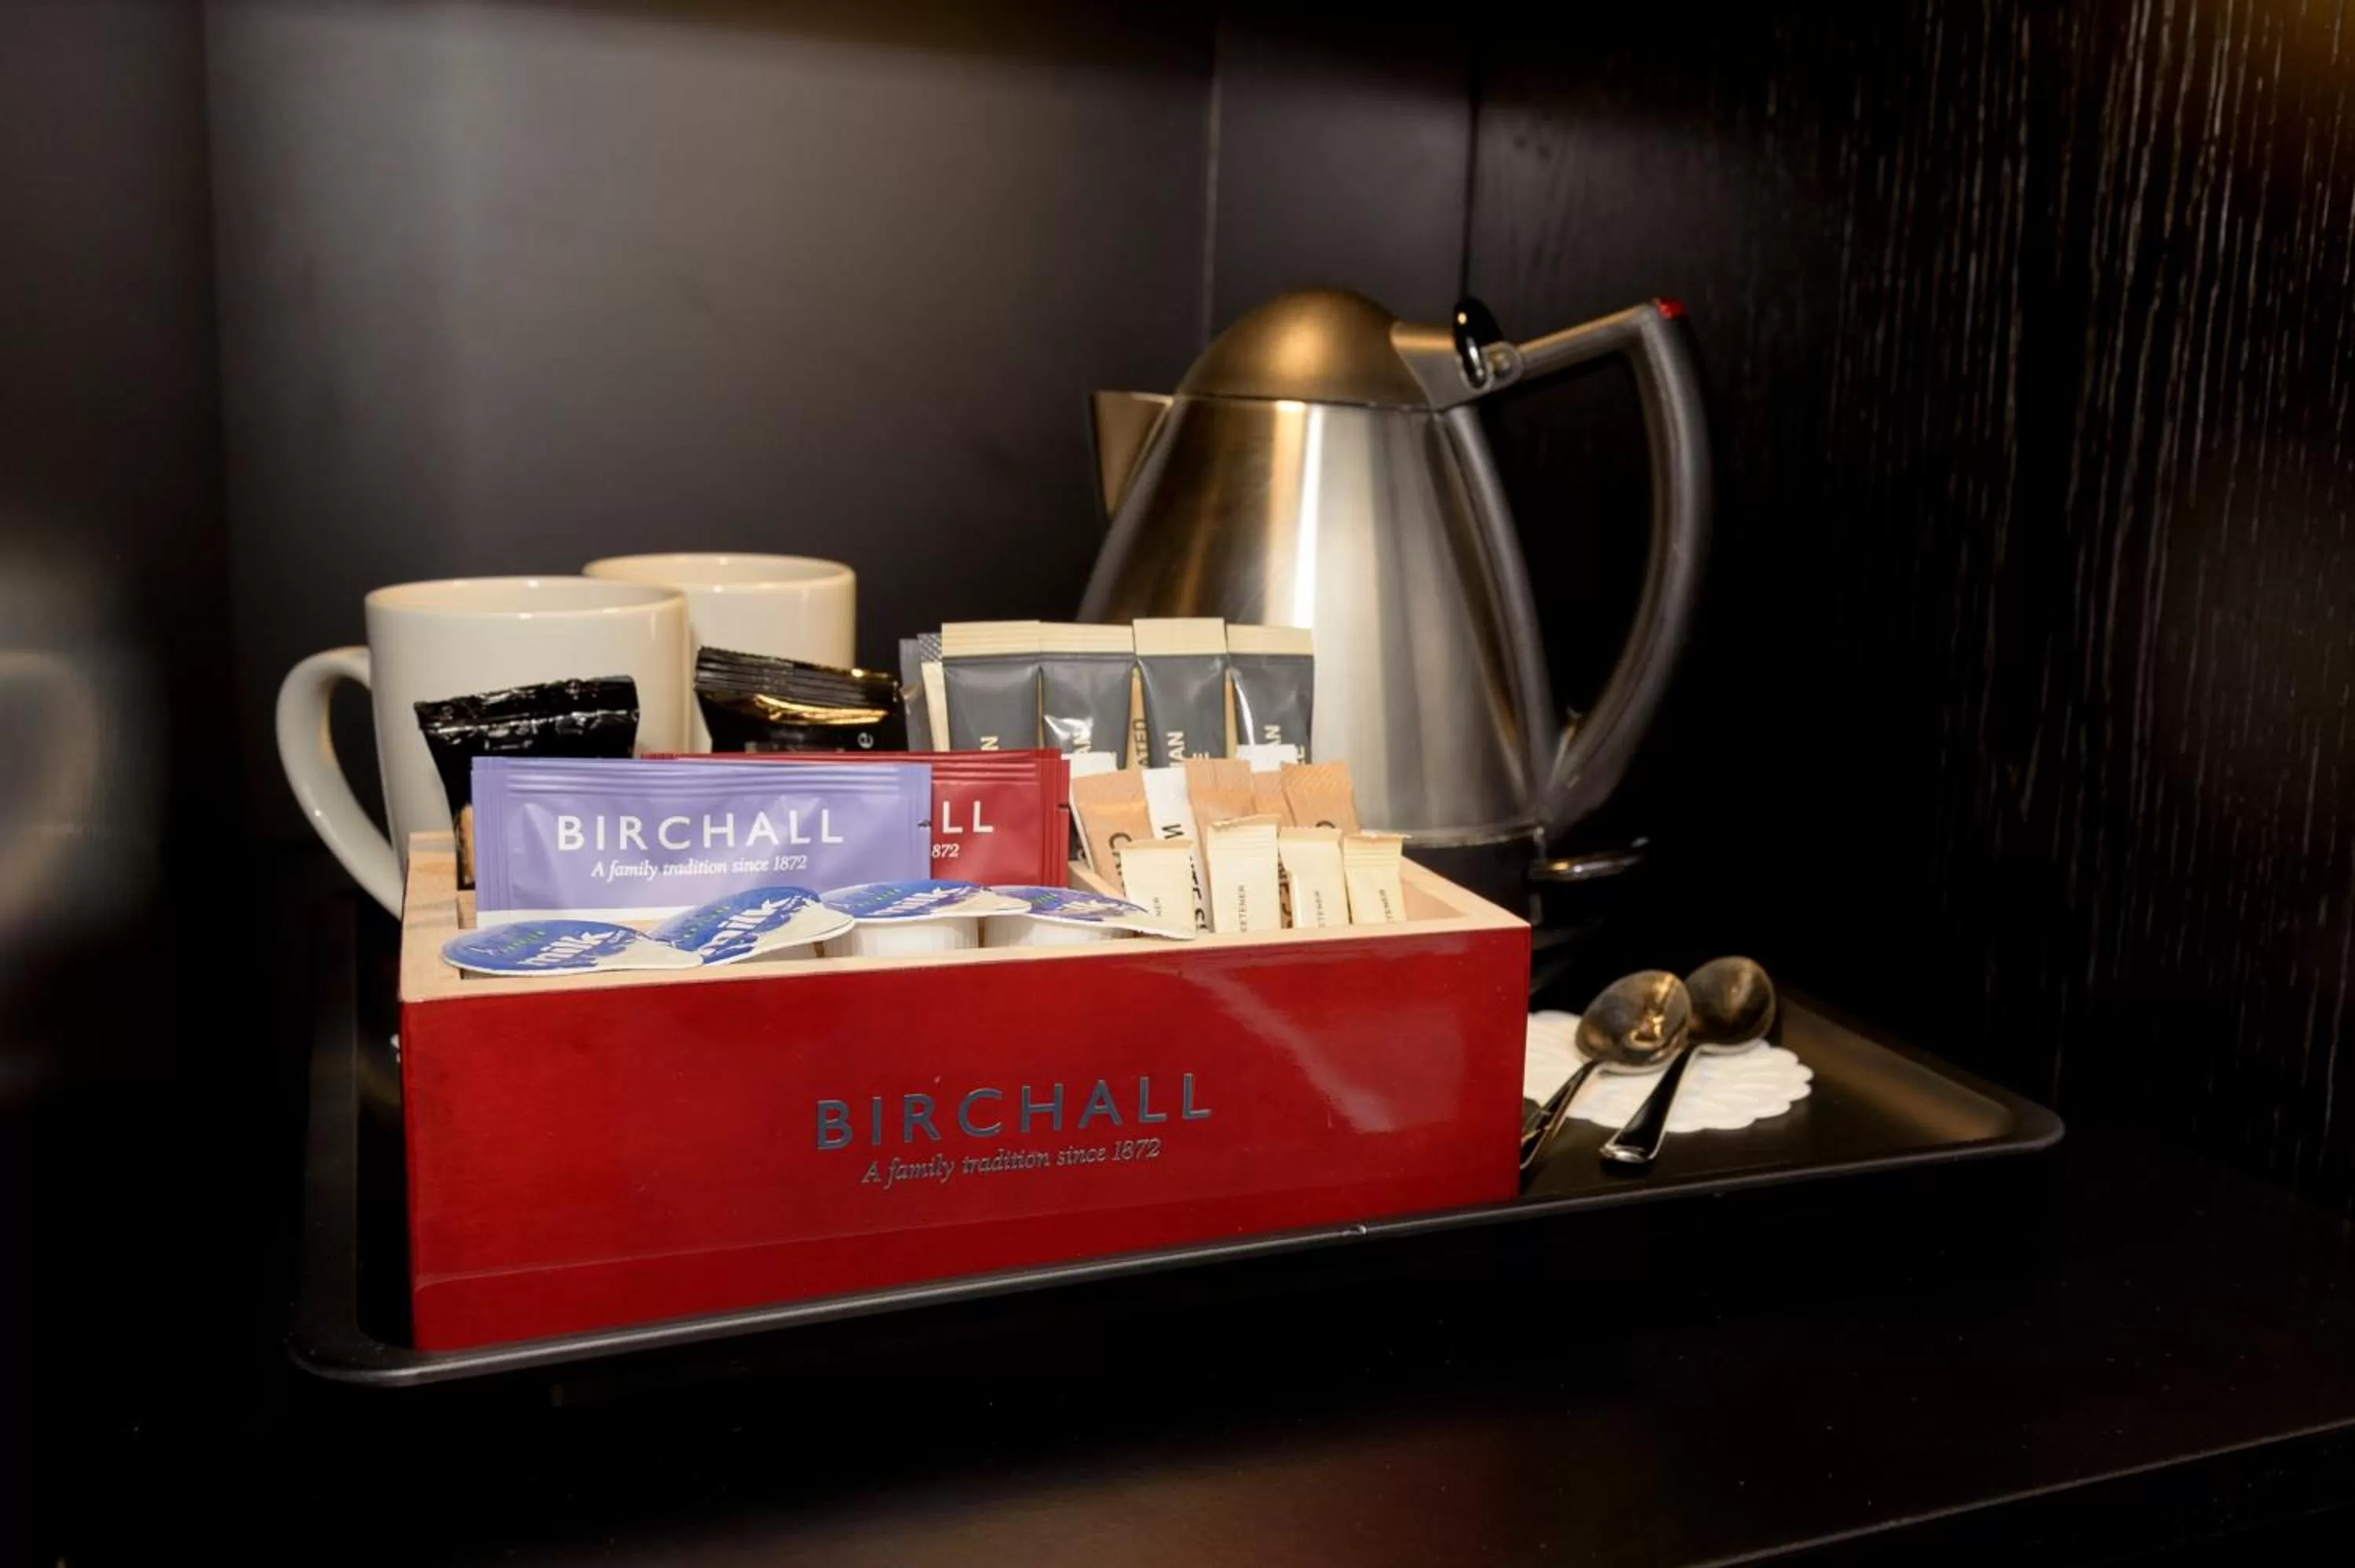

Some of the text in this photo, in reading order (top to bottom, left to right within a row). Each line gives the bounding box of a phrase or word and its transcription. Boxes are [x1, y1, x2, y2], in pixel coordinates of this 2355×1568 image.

[558, 809, 843, 851] BIRCHALL
[592, 855, 808, 883] A family tradition since 1872
[932, 843, 960, 859] 872
[517, 932, 615, 965] milk
[817, 1073, 1212, 1150] BIRCHALL
[862, 1138, 1161, 1189] A family tradition since 1872
